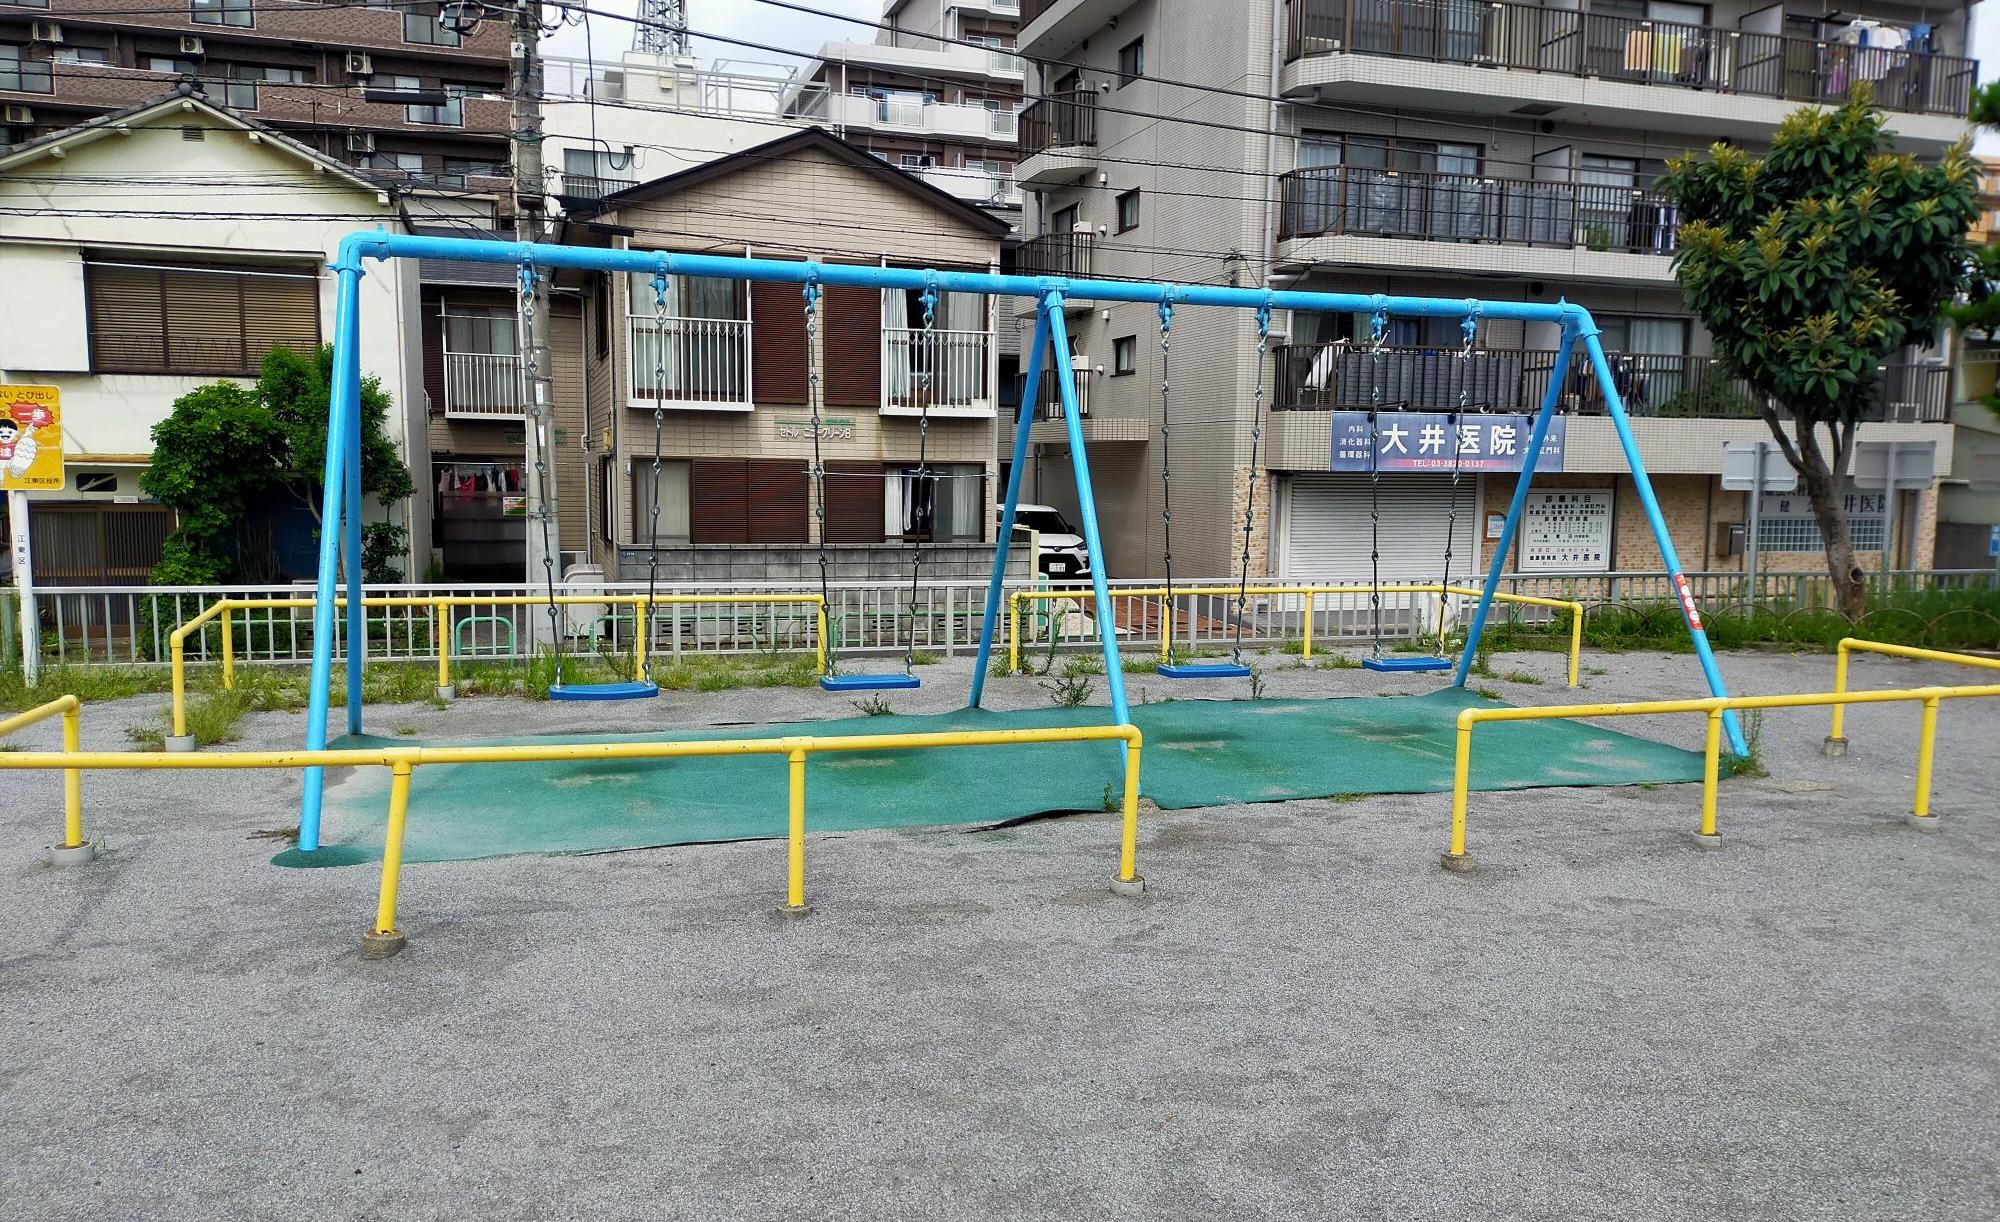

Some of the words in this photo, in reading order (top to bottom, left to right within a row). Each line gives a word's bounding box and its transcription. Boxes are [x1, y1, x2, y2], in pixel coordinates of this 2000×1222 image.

[17, 391, 54, 399] とび出し
[1348, 425, 1364, 433] 内科
[1339, 438, 1371, 446] 消化器科
[1381, 424, 1516, 455] 大井医院
